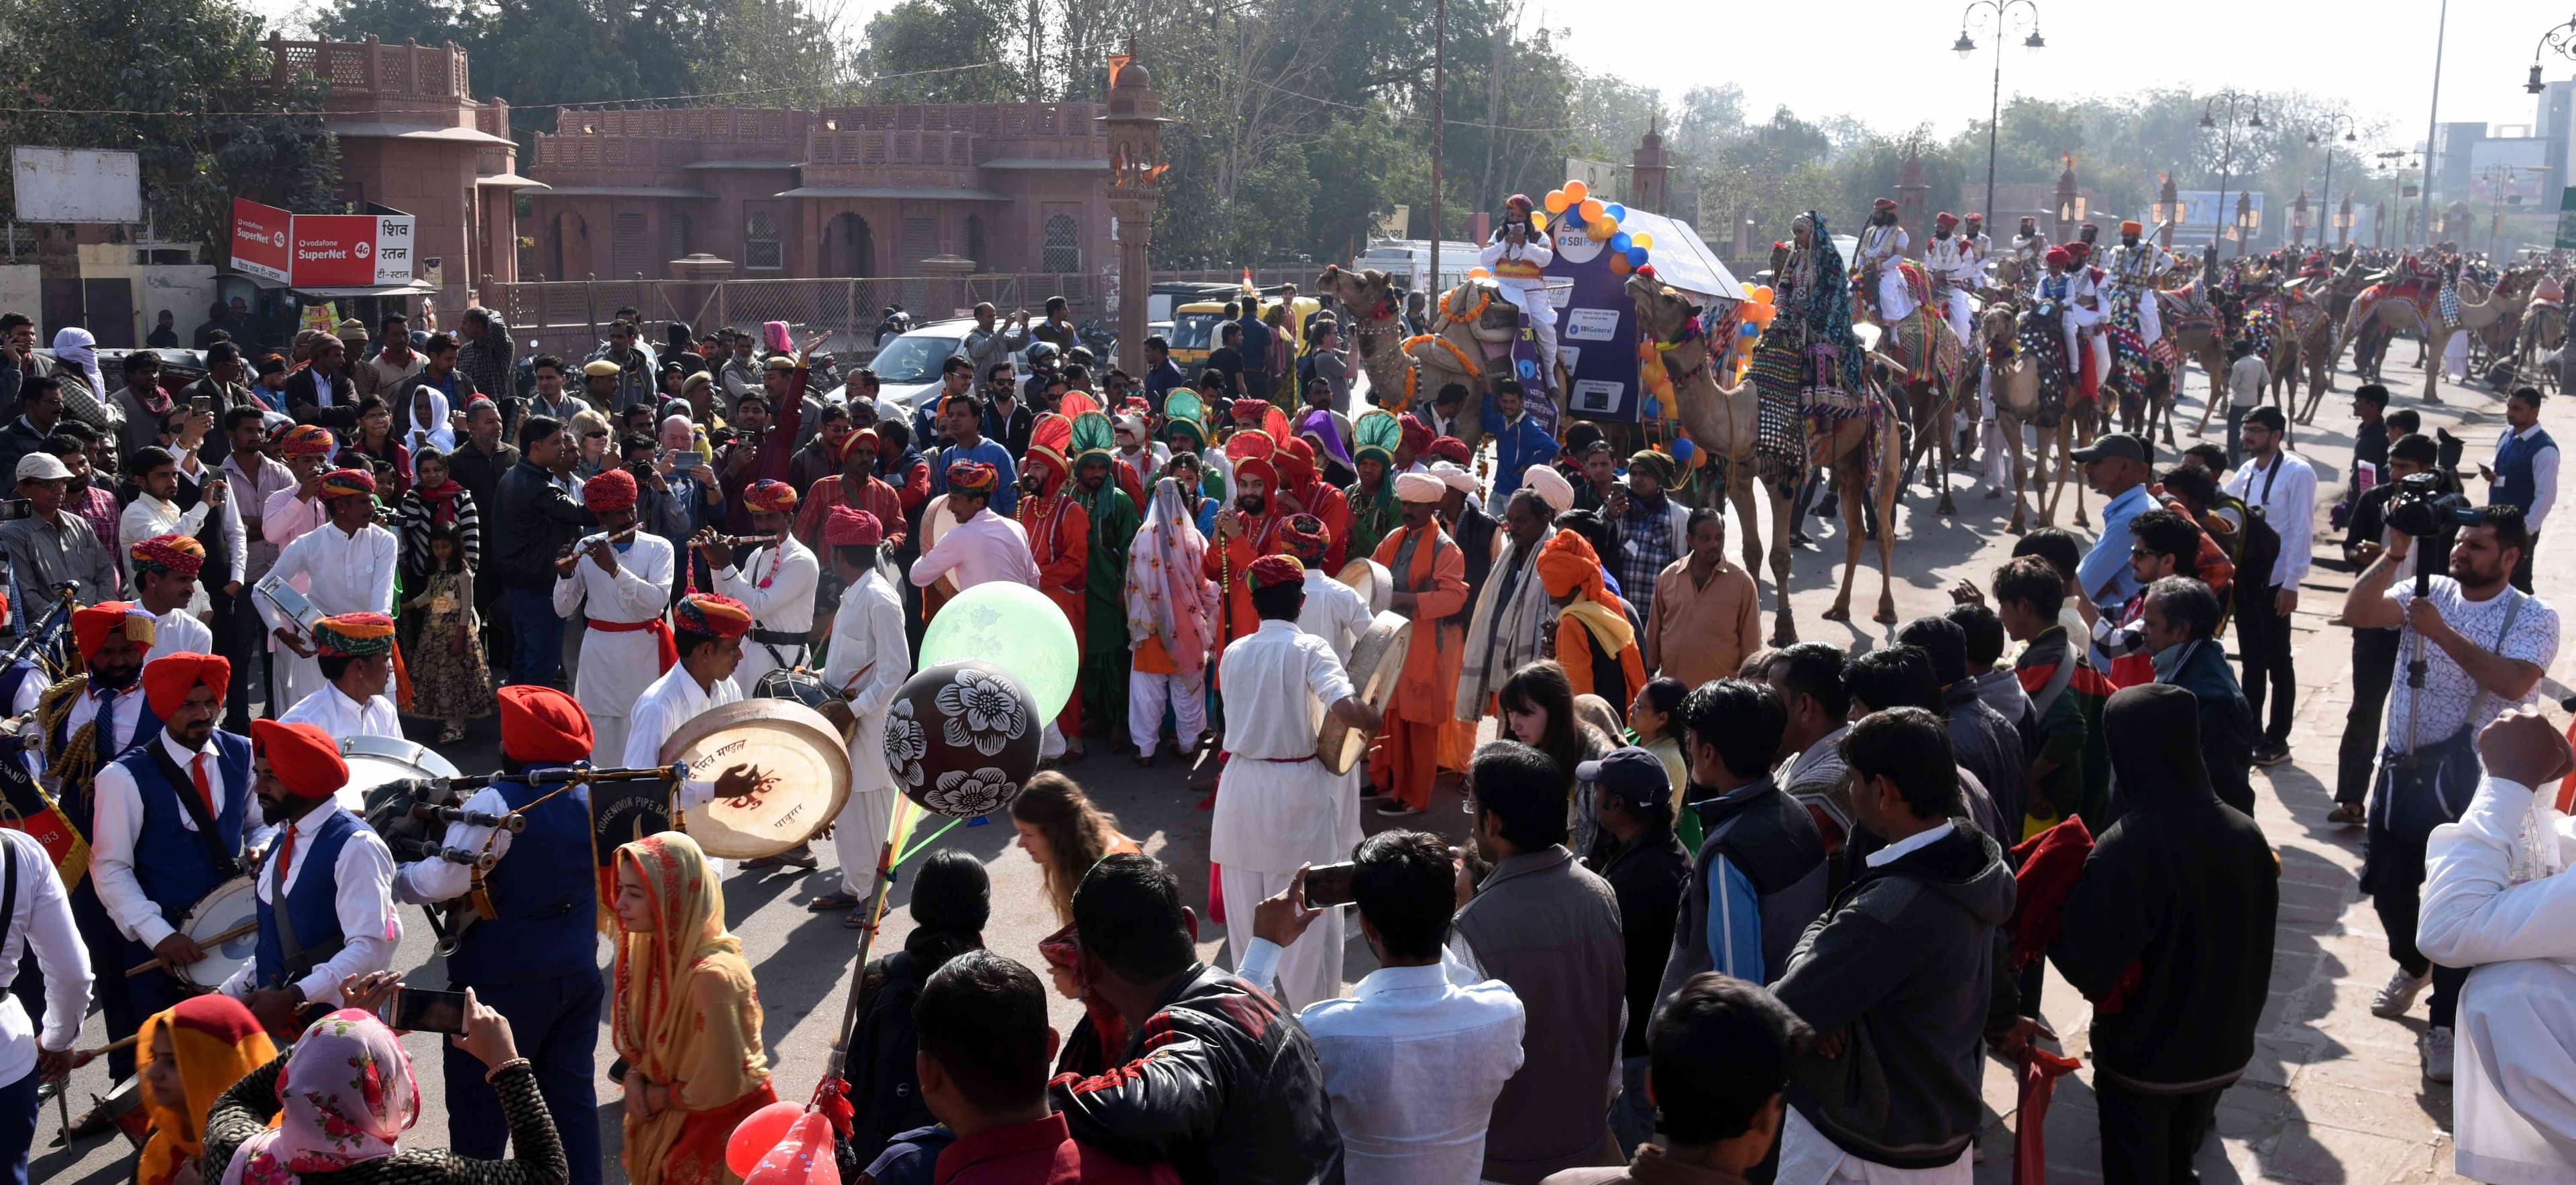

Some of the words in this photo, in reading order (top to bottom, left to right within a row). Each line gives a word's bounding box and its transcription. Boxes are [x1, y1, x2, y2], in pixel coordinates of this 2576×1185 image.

[237, 227, 269, 244] SuperNet
[275, 233, 284, 245] 4G
[382, 219, 409, 236] शिव
[299, 249, 347, 262] SuperNet
[356, 244, 369, 255] 4G
[381, 248, 407, 260] रतन
[692, 754, 716, 772] मित्र
[716, 738, 747, 757] मण्डल
[596, 796, 633, 835] KOHENOOR
[635, 796, 655, 811] PIPE
